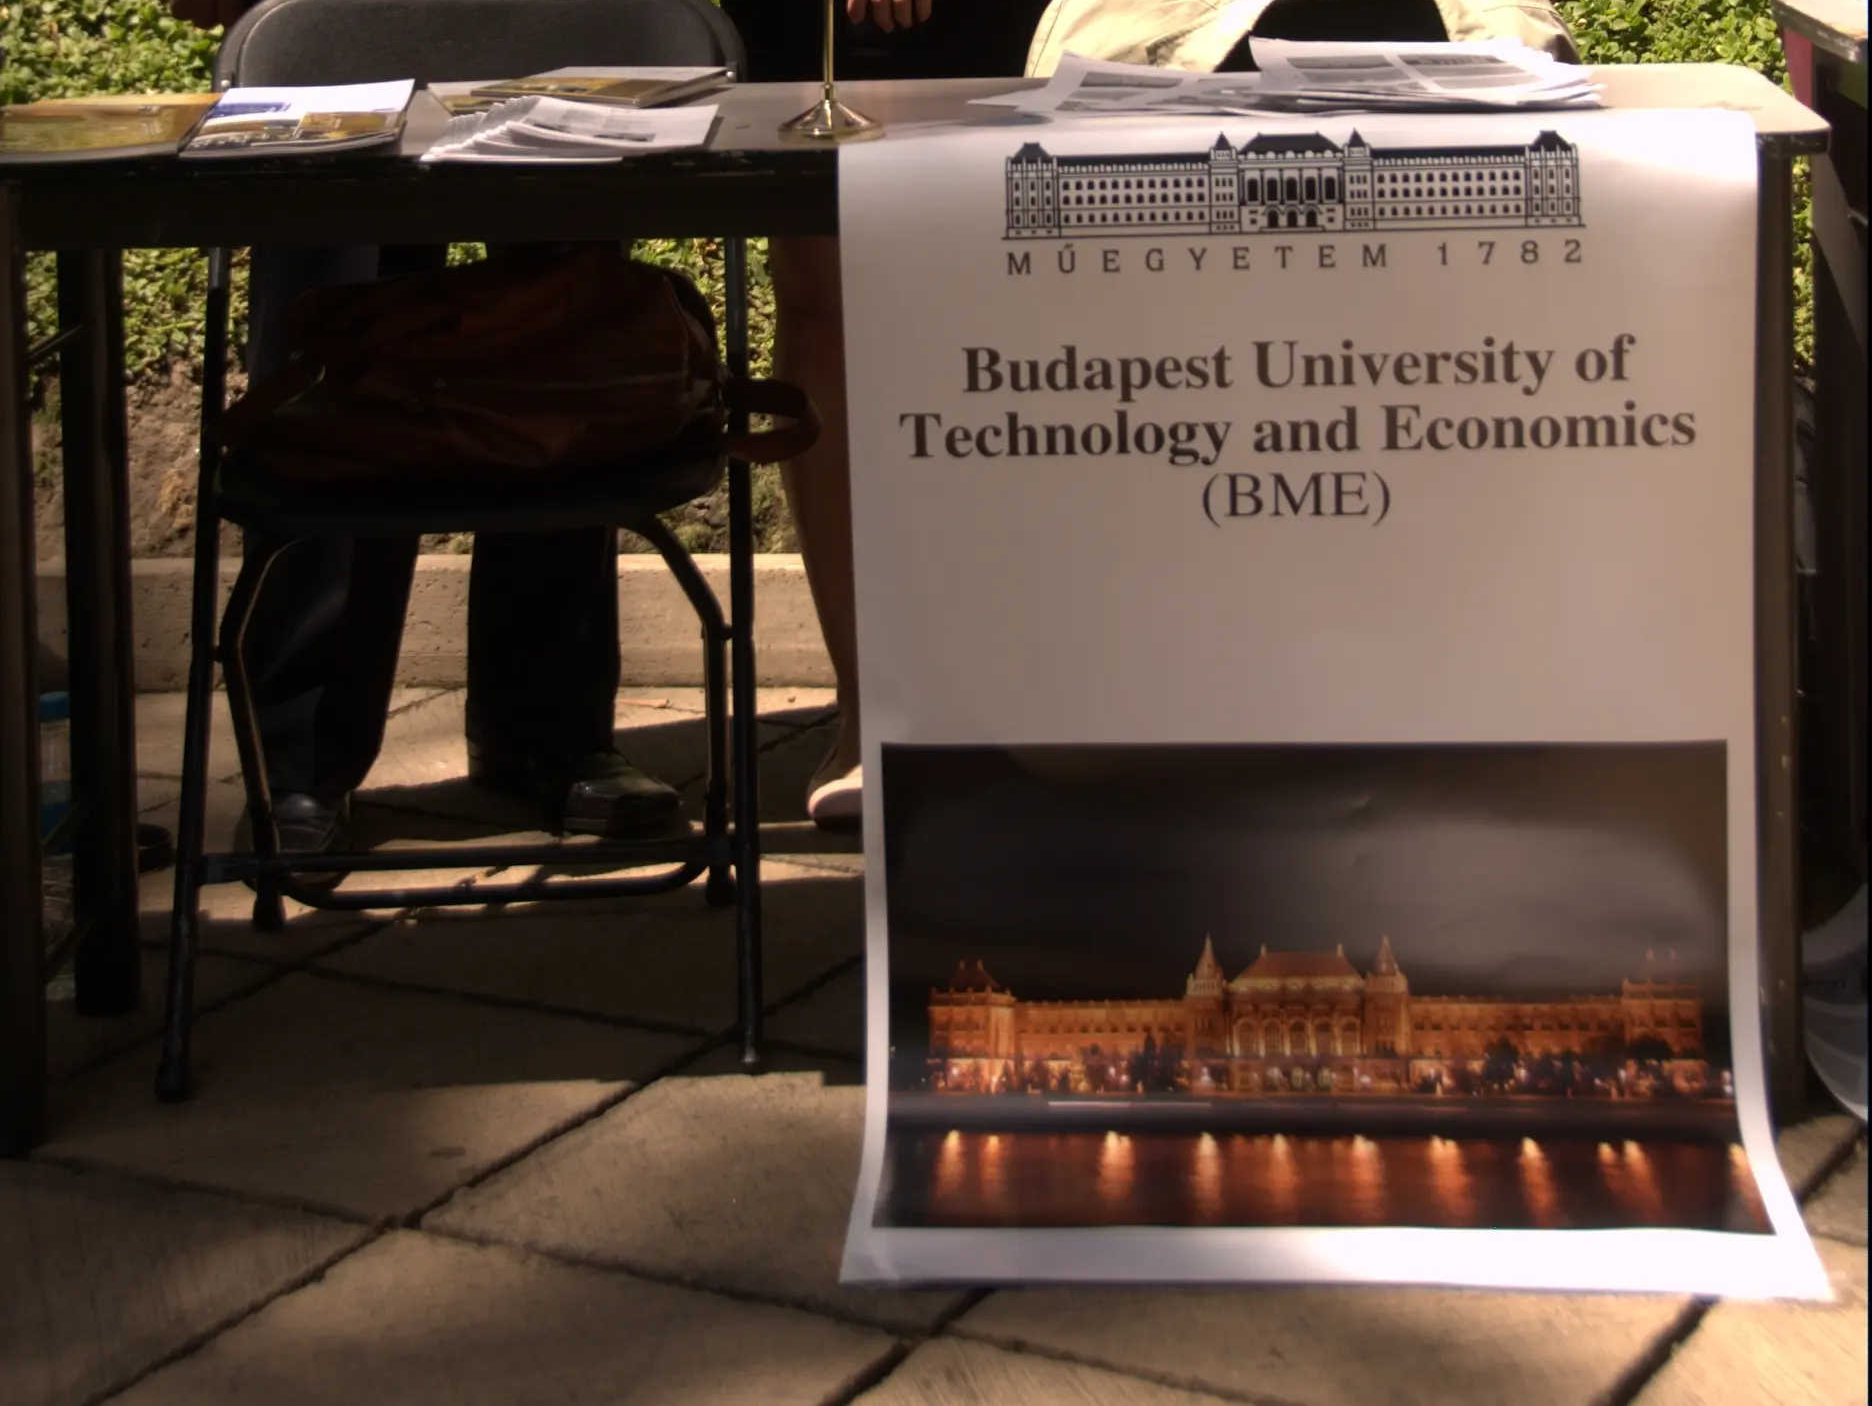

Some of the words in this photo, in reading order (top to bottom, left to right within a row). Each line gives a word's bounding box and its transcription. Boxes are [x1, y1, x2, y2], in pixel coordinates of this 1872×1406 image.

[1007, 242, 1388, 276] MŰEGYETEM
[1438, 240, 1583, 266] 1782
[962, 341, 1233, 403] Budapest
[1252, 337, 1554, 397] University
[1575, 333, 1636, 382] of
[899, 409, 1232, 467] Technology
[1253, 405, 1360, 454] and
[1382, 400, 1696, 451] Economics
[1202, 471, 1391, 527] (BME)
